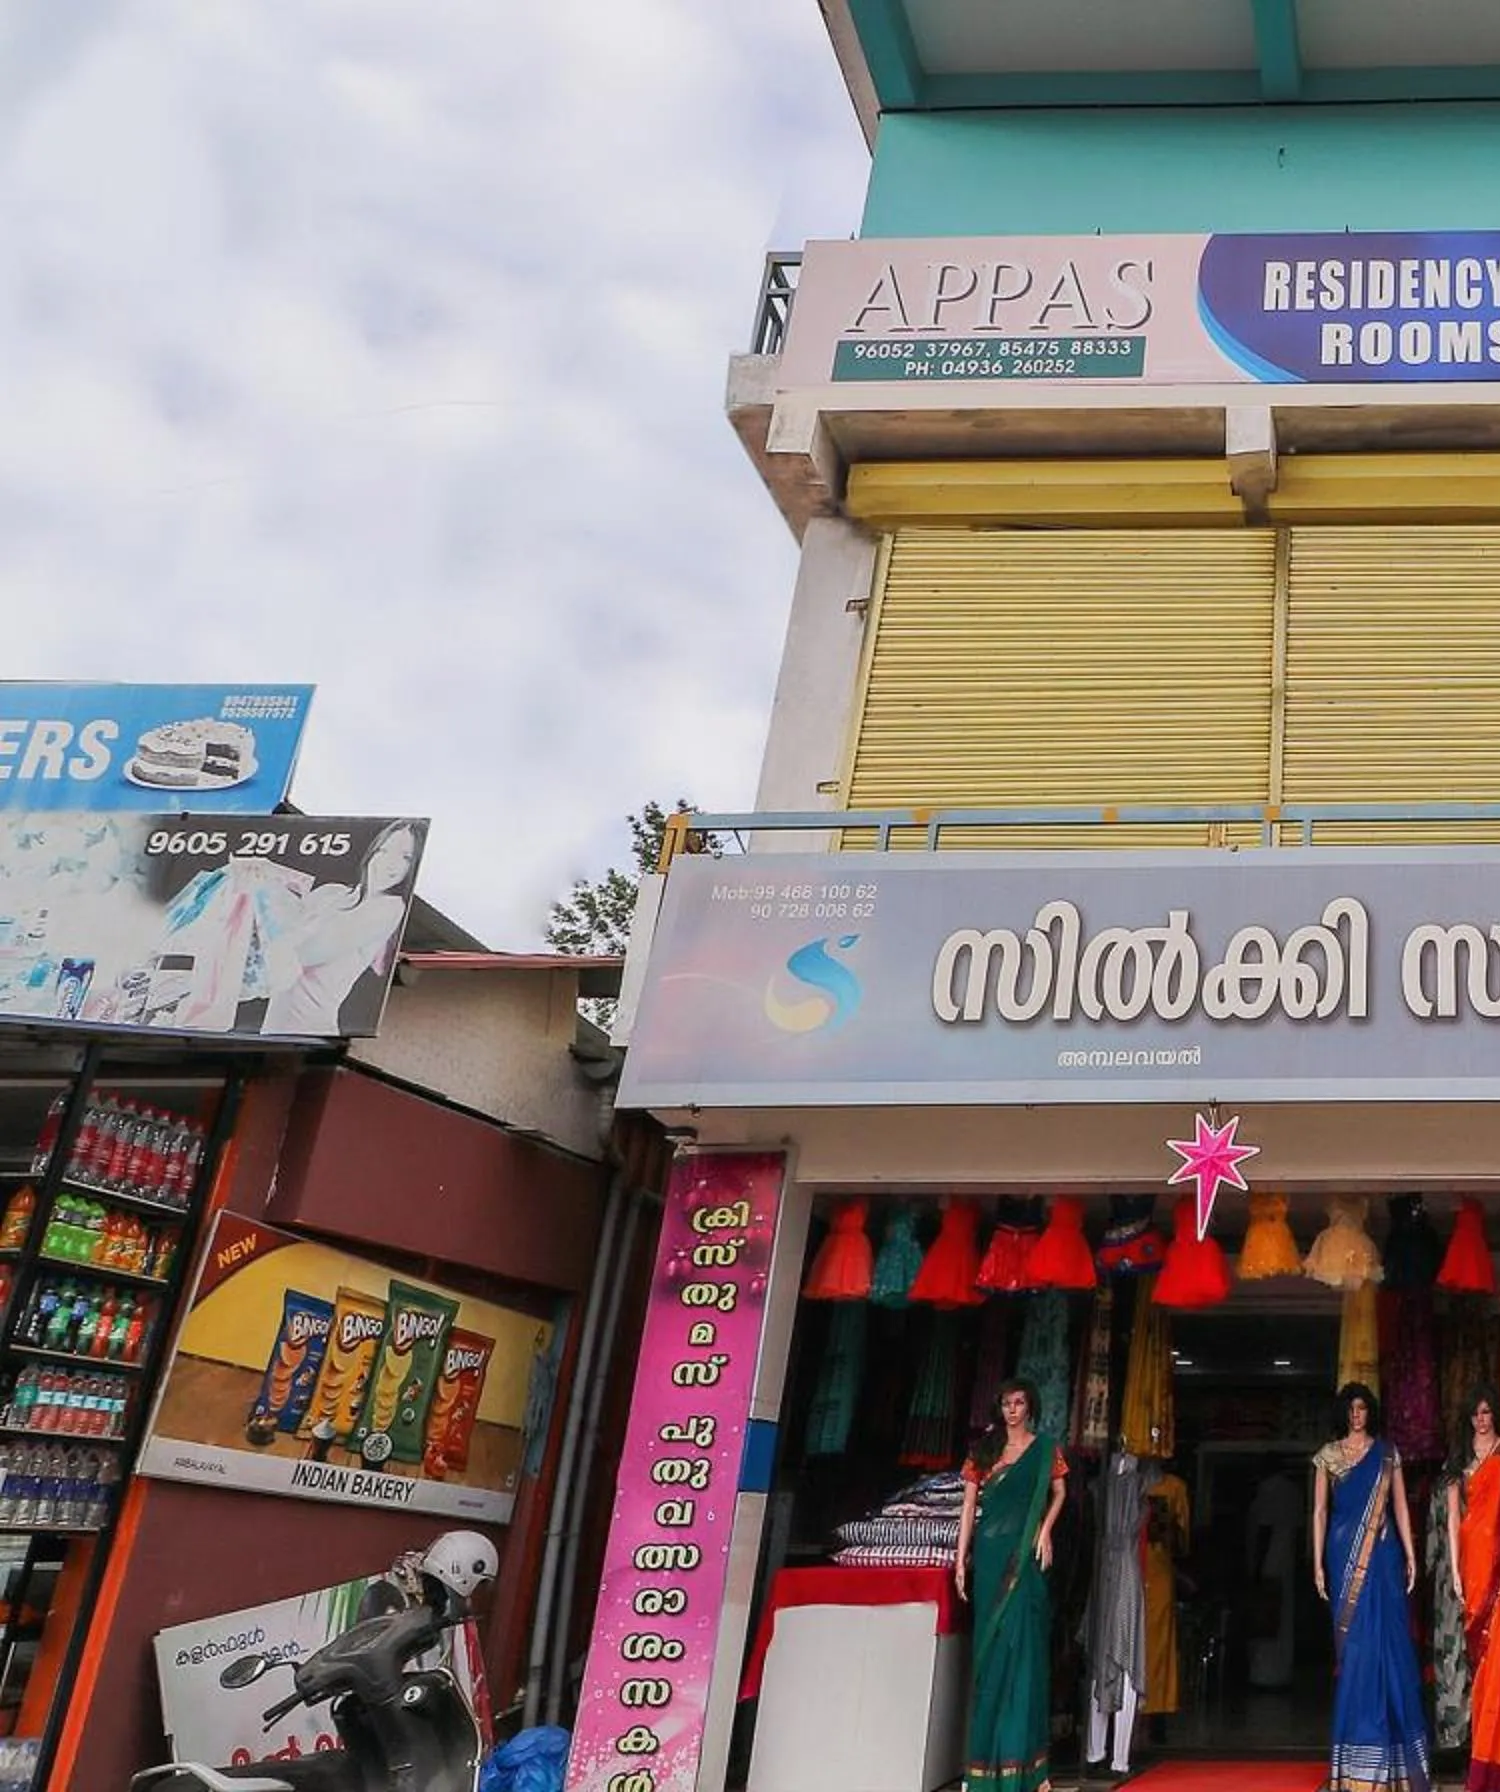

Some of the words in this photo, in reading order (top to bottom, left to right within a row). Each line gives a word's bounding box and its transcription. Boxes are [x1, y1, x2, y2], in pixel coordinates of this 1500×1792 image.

[843, 259, 1154, 333] APPAS
[854, 343, 915, 359] 96052
[925, 342, 992, 359] 37967,
[999, 341, 1060, 357] 85475
[1070, 340, 1132, 355] 88333
[904, 360, 935, 377] PH:
[942, 360, 1004, 376] 04936
[1012, 359, 1076, 375] 260252
[145, 831, 228, 856] 9605
[235, 831, 290, 856] 291
[298, 832, 352, 858] 615
[821, 884, 850, 900] 100
[855, 884, 878, 900] 62
[750, 903, 772, 919] 90
[932, 897, 1371, 1023] സിൽക്കി
[216, 1233, 258, 1269] NEW
[397, 1312, 446, 1347] BINGO!
[291, 1463, 349, 1494] INDIAN
[350, 1470, 416, 1502] BAKERY
